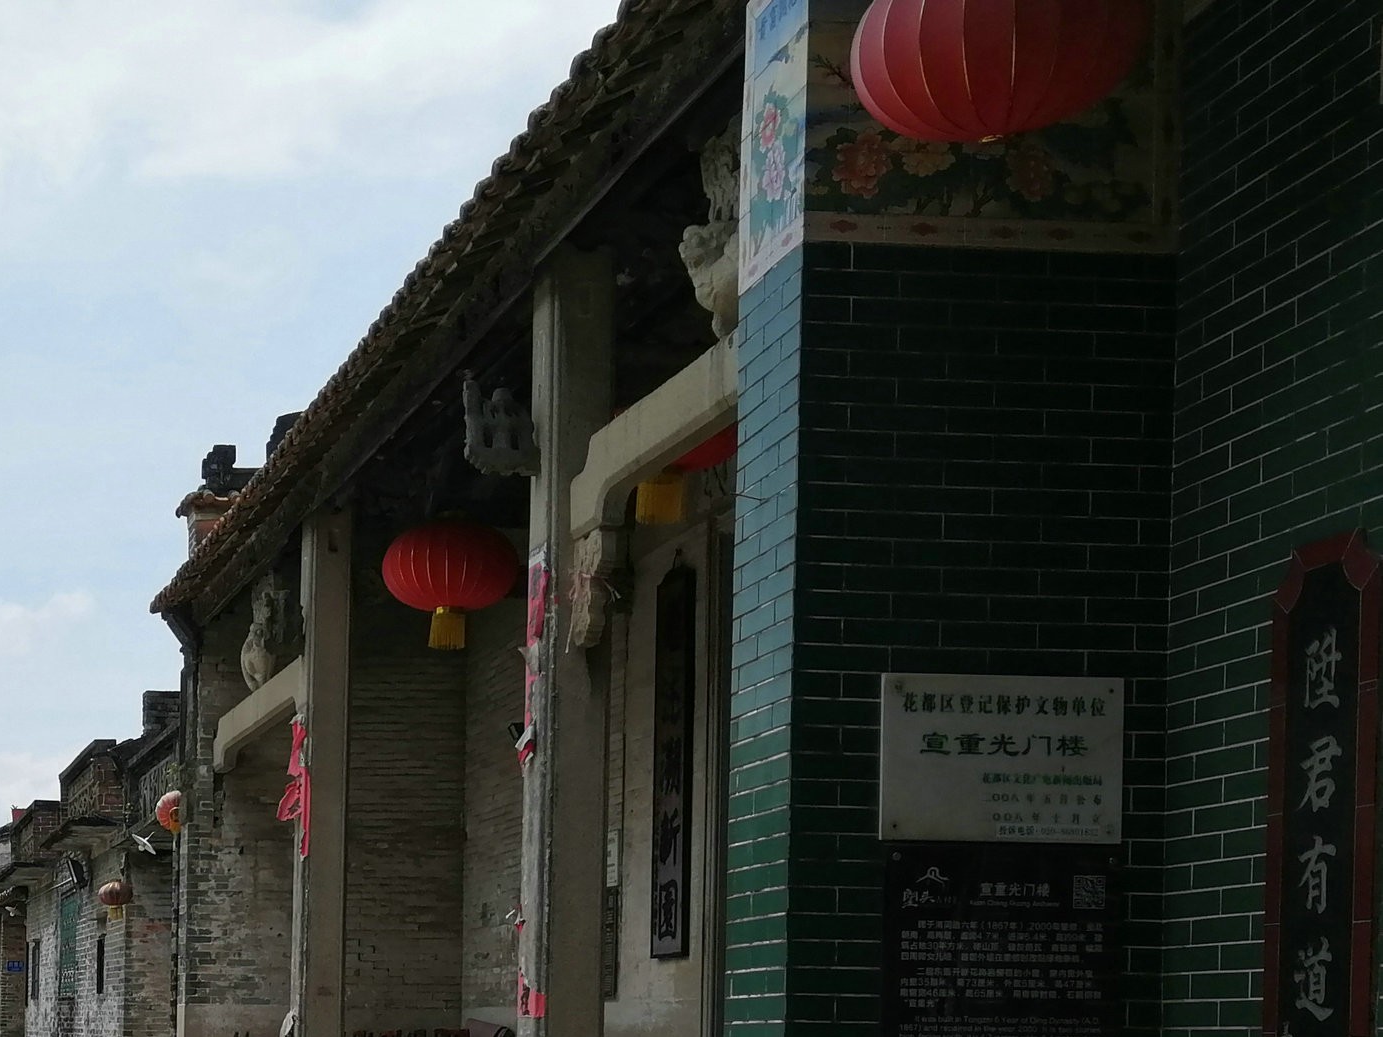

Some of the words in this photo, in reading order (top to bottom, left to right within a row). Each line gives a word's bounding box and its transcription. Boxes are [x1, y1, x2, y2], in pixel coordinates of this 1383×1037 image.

[902, 691, 1107, 718] 花都区登记保护文物单位
[920, 731, 1089, 757] 宣重光门楼
[979, 882, 1050, 897] 宣重光门楼
